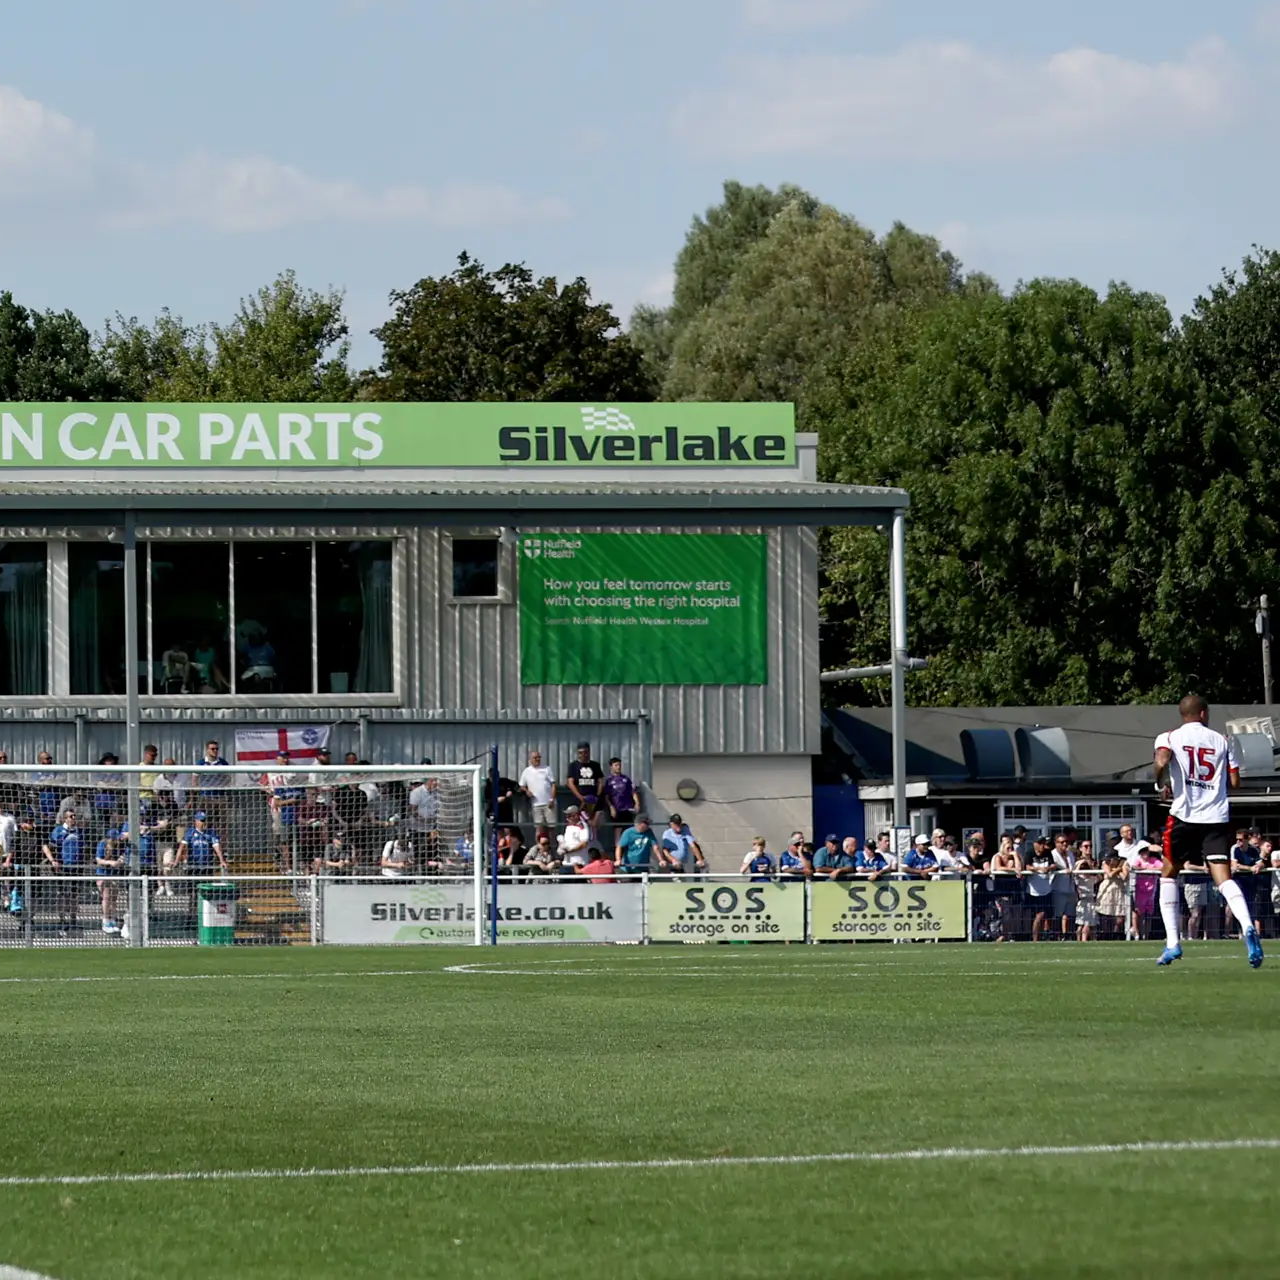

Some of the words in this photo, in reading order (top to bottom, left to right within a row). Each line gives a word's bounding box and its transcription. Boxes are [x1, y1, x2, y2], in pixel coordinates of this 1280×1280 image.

[58, 412, 185, 460] CAR
[199, 412, 384, 460] PARTS
[498, 426, 786, 461] Silverlake
[544, 539, 581, 549] Nuffield
[544, 549, 575, 558] Health
[544, 579, 572, 590] How
[576, 580, 600, 593] you
[603, 578, 627, 590] feel
[629, 580, 692, 591] tomorrow
[695, 580, 731, 591] starts
[544, 595, 571, 606] with
[574, 594, 631, 609] choosing
[634, 596, 656, 607] the
[658, 595, 687, 610] right
[690, 595, 741, 609] hospital
[1183, 746, 1216, 781] 15
[685, 887, 765, 913] SOS
[848, 886, 927, 912] SOS
[436, 928, 509, 938] automtve
[513, 927, 564, 939] recycling
[669, 921, 724, 936] storage
[731, 922, 749, 933] on
[755, 920, 780, 933] site
[832, 920, 887, 935] storage
[894, 919, 911, 932] on
[916, 917, 942, 931] site
